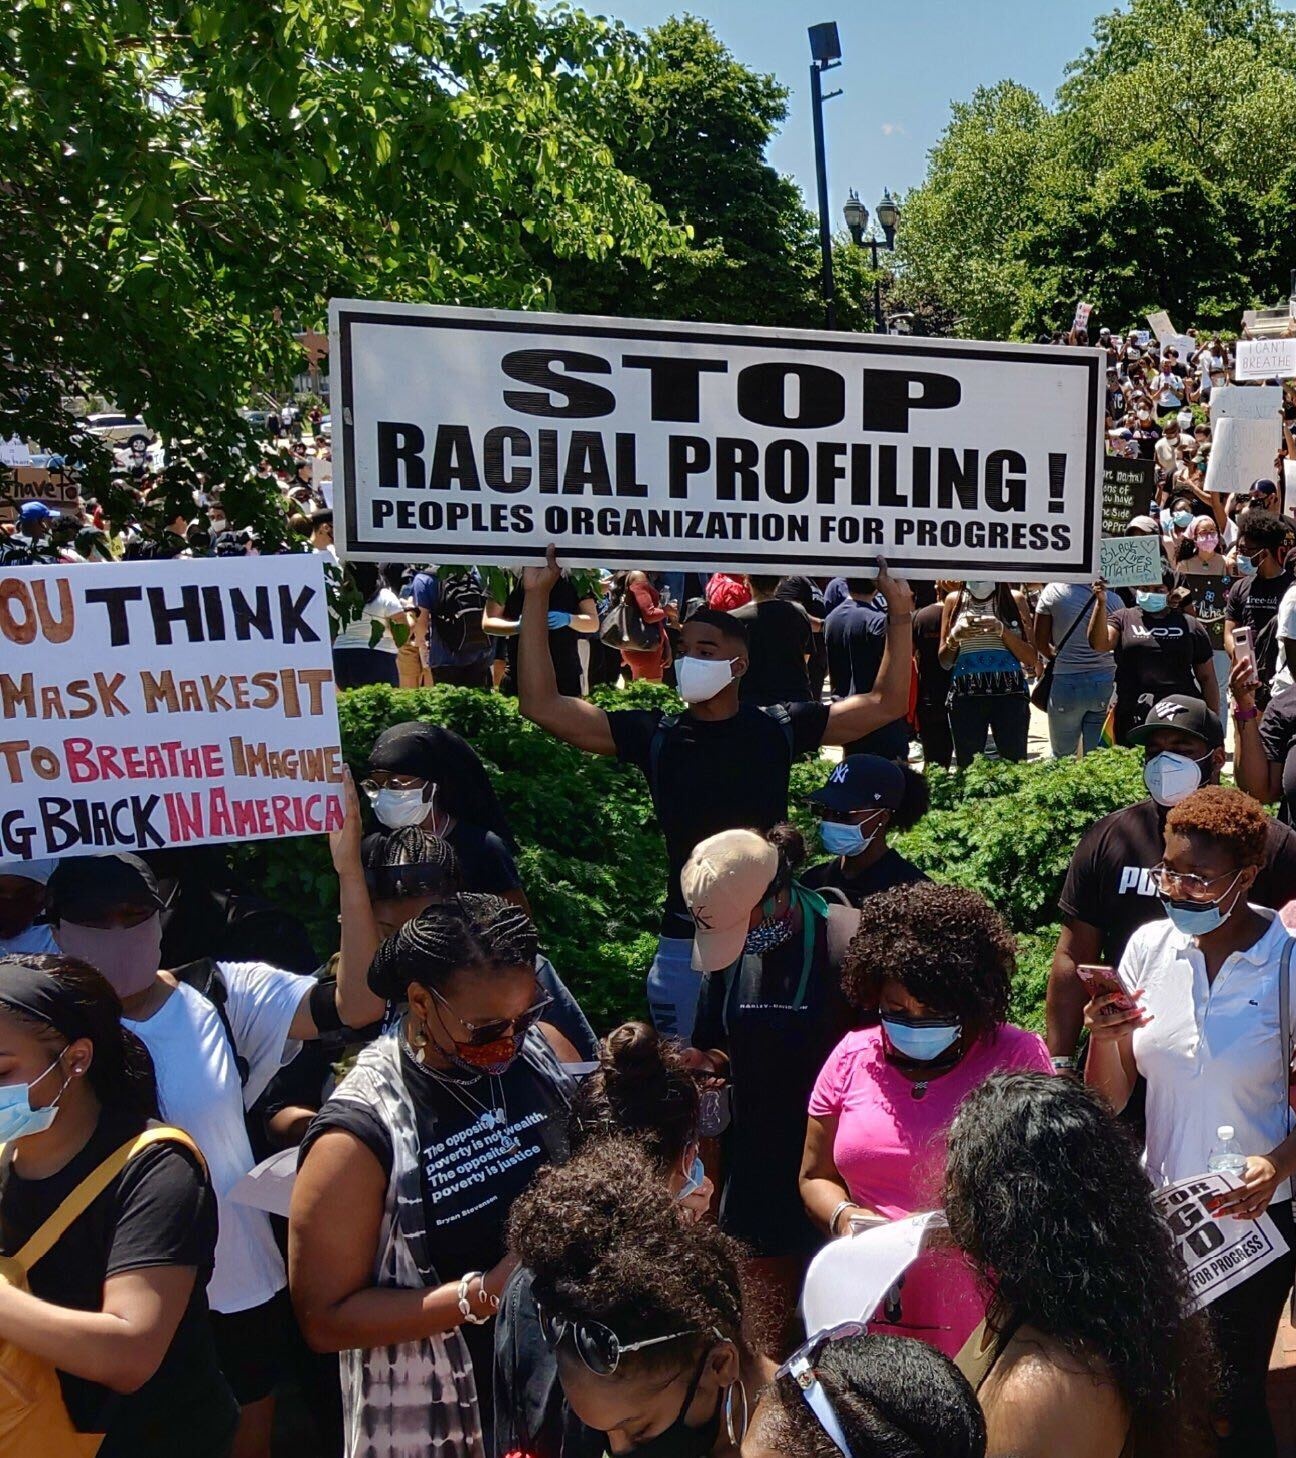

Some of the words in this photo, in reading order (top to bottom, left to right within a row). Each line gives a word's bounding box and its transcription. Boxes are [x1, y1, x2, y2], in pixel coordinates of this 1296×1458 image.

[1242, 356, 1291, 370] BREATHE
[501, 348, 961, 433] STOP
[377, 421, 648, 497] RACIAL
[14, 467, 55, 498] have
[1119, 484, 1130, 495] of
[1114, 494, 1134, 506] have
[371, 499, 534, 533] PEOPLES
[545, 505, 809, 543] ORGANIZATION
[820, 515, 884, 545] FOR
[895, 518, 1071, 551] PROGRESS
[1101, 541, 1138, 563] BLACK
[1119, 550, 1153, 566] LIVES
[1101, 562, 1152, 577] MATTER
[85, 584, 322, 648] THINK
[1, 671, 131, 720] MASK
[140, 669, 279, 714] MAKES
[279, 668, 333, 718] IT
[1, 739, 61, 783] TO
[63, 737, 225, 784] BREATHE
[229, 735, 343, 784] IMAGINE
[38, 793, 166, 854] BLACK
[164, 791, 201, 842] IN
[208, 786, 345, 838] AMERICA
[1118, 866, 1162, 897] PU
[423, 1141, 446, 1161] The
[425, 1145, 473, 1176] poverty
[470, 1139, 485, 1151] is
[483, 1130, 503, 1146] not
[503, 1110, 549, 1138] wealth.
[428, 1169, 456, 1189] The
[430, 1169, 486, 1204] poverty
[483, 1161, 499, 1176] is
[498, 1144, 542, 1174] justice
[1155, 1181, 1212, 1216] FOR
[435, 1212, 461, 1227] Bryan
[1191, 1266, 1214, 1290] FOR
[1212, 1233, 1264, 1277] PROGRESS
